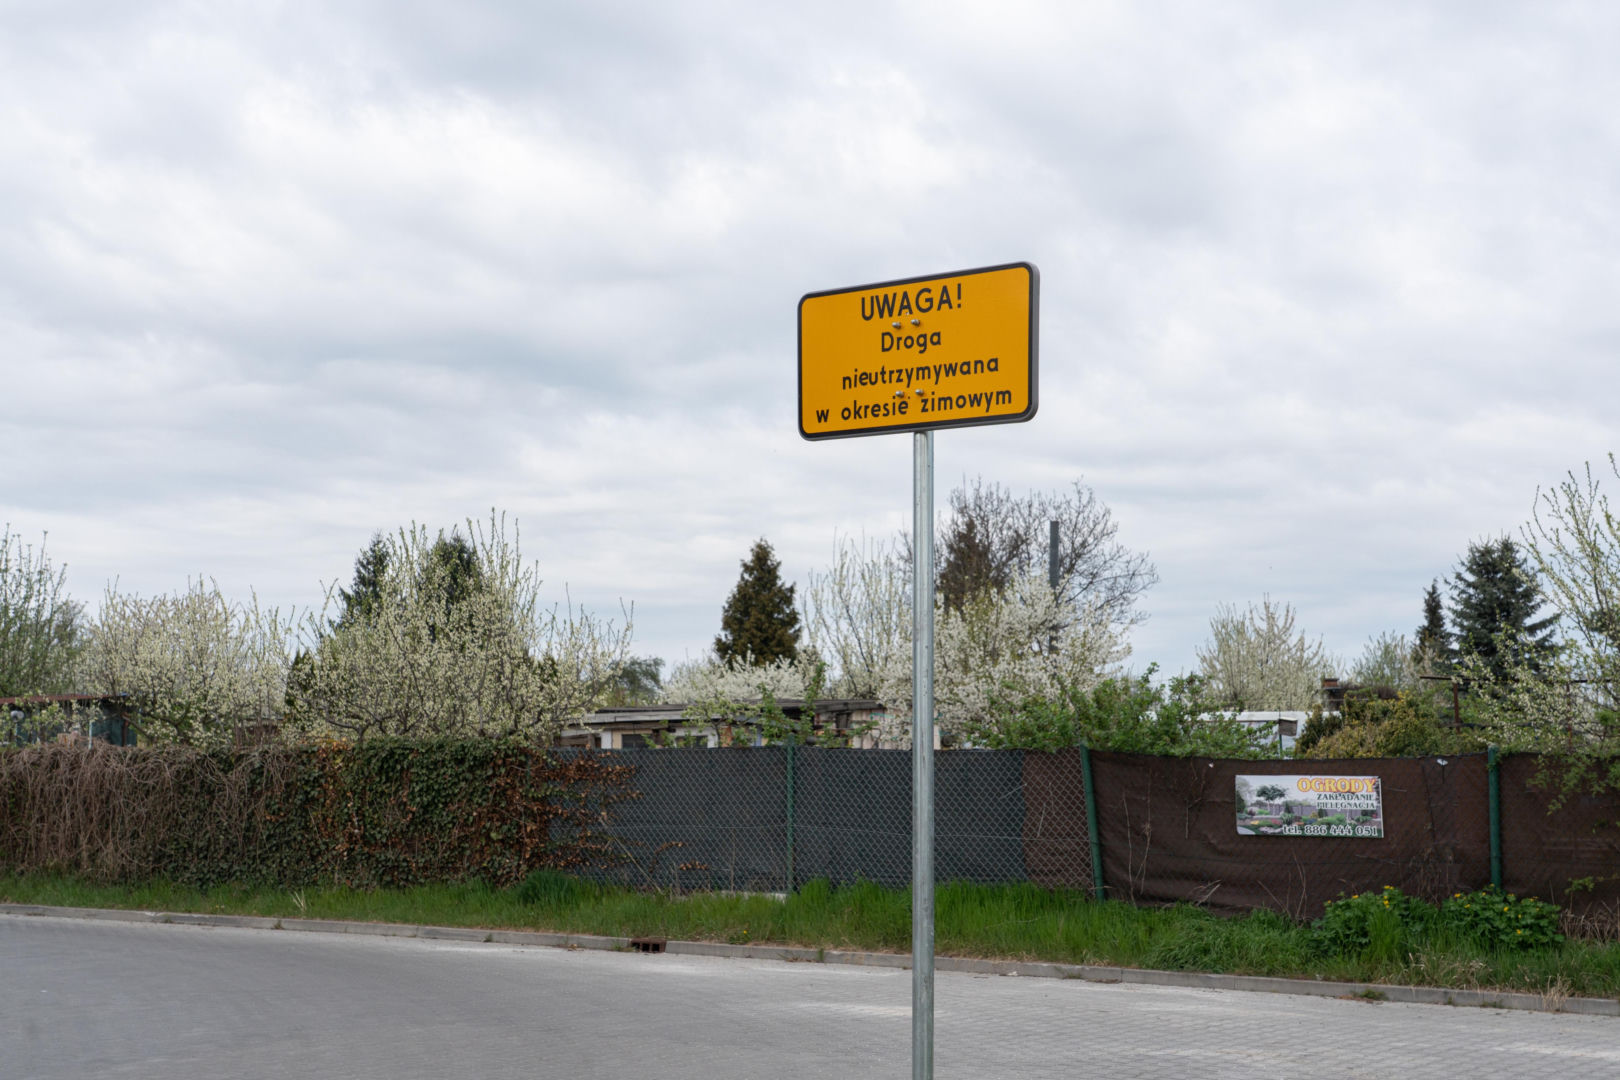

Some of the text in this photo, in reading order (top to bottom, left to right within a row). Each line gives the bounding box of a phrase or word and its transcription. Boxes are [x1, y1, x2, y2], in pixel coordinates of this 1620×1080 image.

[861, 283, 962, 321] UWAGA!
[881, 331, 941, 354] Droga
[842, 357, 999, 390] nieutrzymywana
[816, 389, 1012, 423] w okresie zimowym
[1297, 777, 1376, 792] OGRODY
[1317, 793, 1374, 801] ZAKŁADANIE
[1282, 825, 1378, 836] tel. 886 444 051
